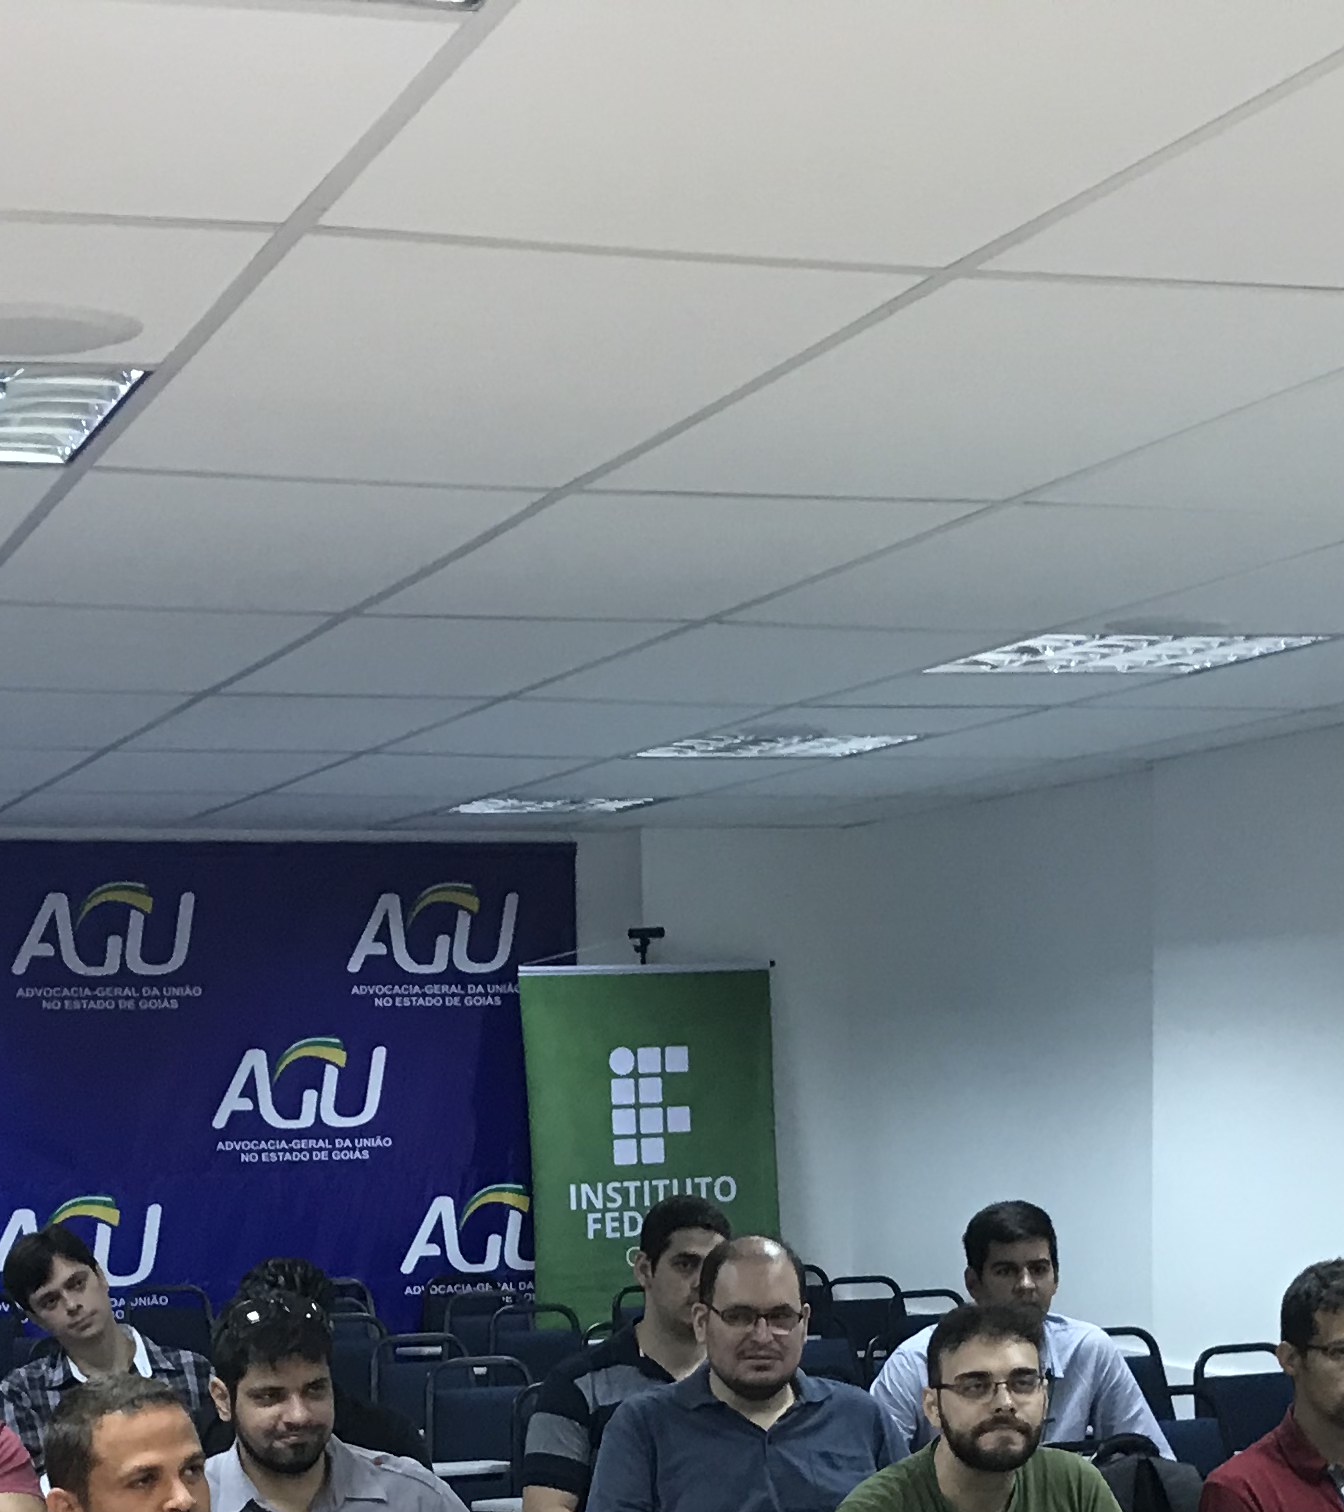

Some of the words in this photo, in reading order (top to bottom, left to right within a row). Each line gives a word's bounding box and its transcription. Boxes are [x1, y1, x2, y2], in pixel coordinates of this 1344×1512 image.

[11, 881, 195, 976] AGU
[346, 882, 519, 974] AGU
[16, 986, 140, 998] ADVOCACIA-GERAL
[142, 986, 160, 997] DA
[351, 984, 465, 995] ADVOCACIA-GERAL
[467, 984, 485, 994] DA
[42, 999, 61, 1010] NO
[64, 999, 115, 1010] ESTADO
[118, 999, 135, 1010] DE
[374, 996, 392, 1007] NO
[395, 996, 442, 1007] ESTADO
[445, 996, 461, 1006] DE
[464, 995, 501, 1006] GOIÁS
[211, 1037, 387, 1130] AGU
[216, 1139, 332, 1151] ADVOCACIA-GERAL
[335, 1138, 352, 1149] DA
[354, 1136, 392, 1148] UNIÃO
[241, 1152, 259, 1163] NO
[262, 1151, 309, 1163] ESTADO
[313, 1151, 329, 1161] DE
[332, 1148, 369, 1160] GOIÁS
[569, 1175, 737, 1210] INSTITUTO
